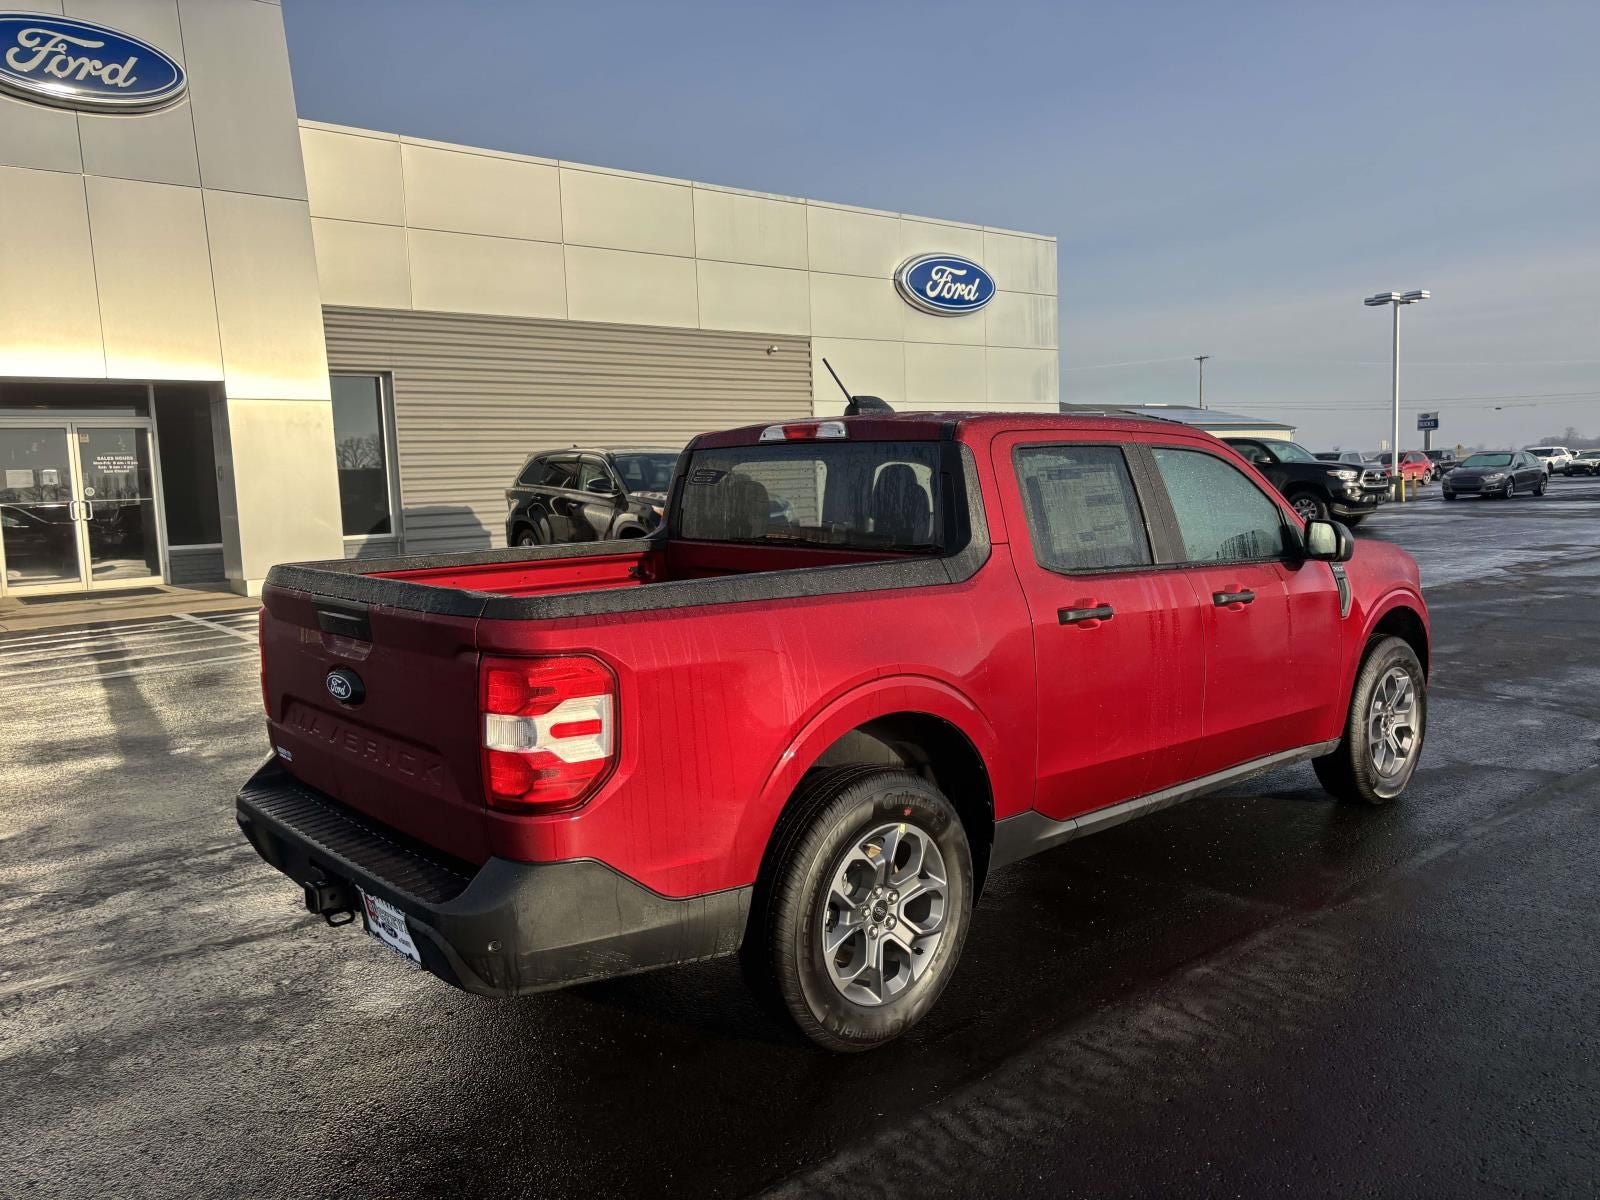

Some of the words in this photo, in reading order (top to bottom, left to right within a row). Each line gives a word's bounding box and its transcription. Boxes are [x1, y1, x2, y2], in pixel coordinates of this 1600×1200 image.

[6, 28, 138, 88] Ford
[926, 265, 980, 301] Ford
[331, 677, 346, 696] Ford
